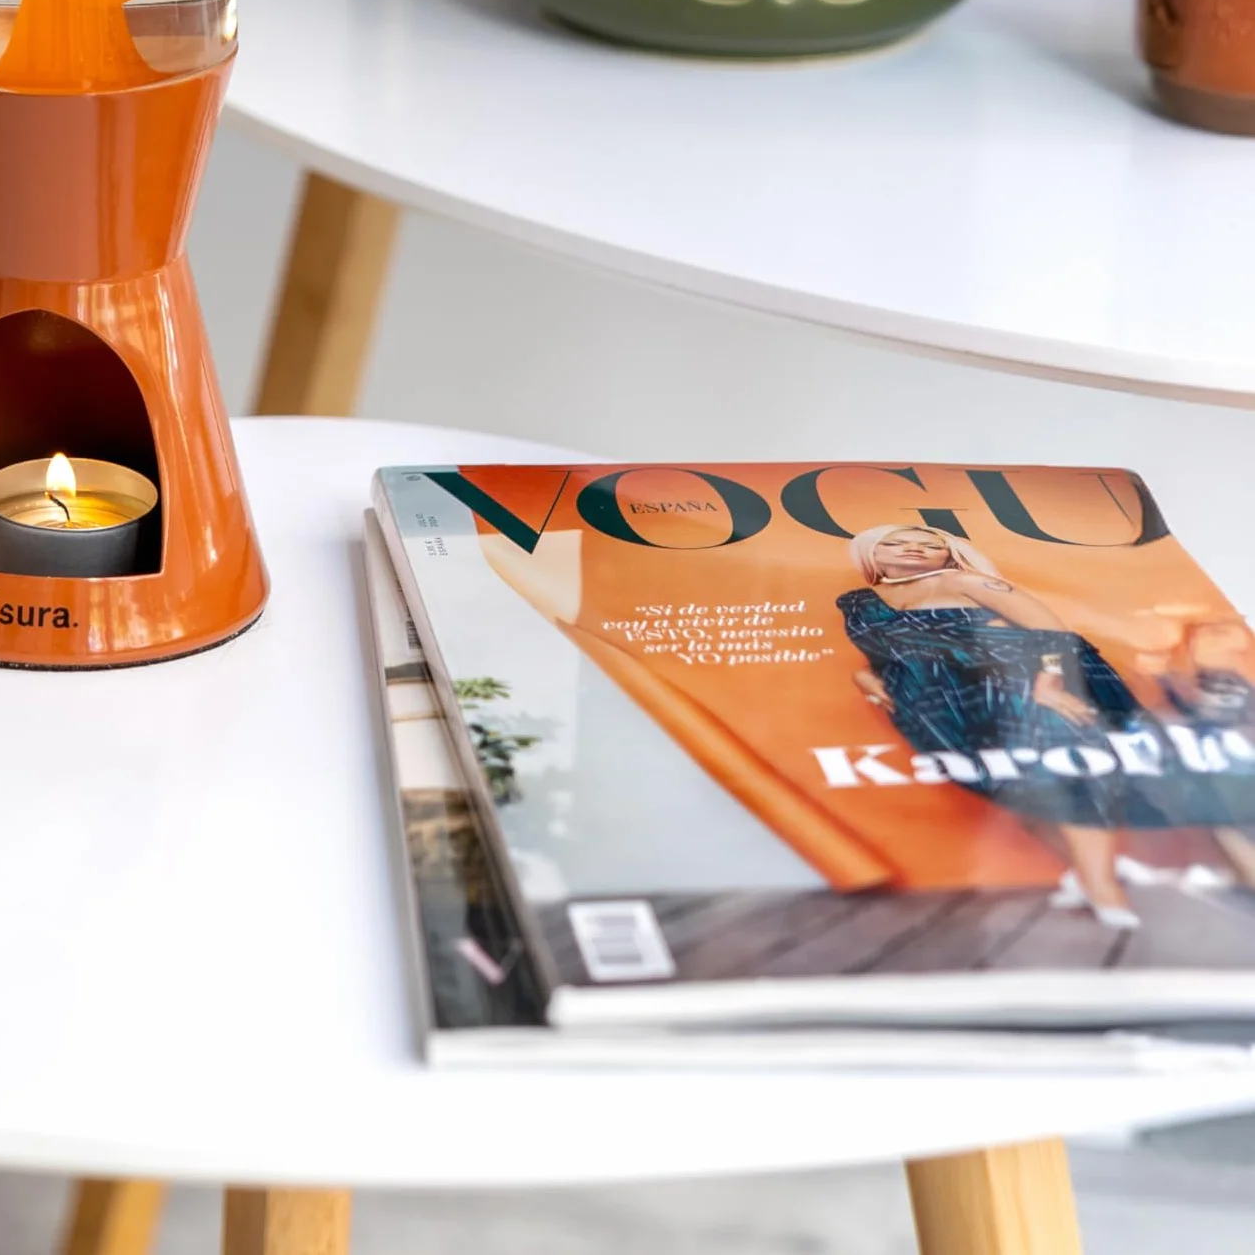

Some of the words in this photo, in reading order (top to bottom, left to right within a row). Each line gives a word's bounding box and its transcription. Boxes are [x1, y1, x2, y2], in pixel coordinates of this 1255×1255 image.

[628, 500, 718, 515] ESPAÑA
[678, 603, 709, 615] de
[715, 600, 806, 615] verdad
[601, 619, 648, 632] voy
[653, 619, 670, 629] a
[677, 615, 740, 628] vivir
[743, 614, 774, 627] de
[625, 628, 714, 642] ESTO,
[719, 625, 824, 639] necesito
[643, 643, 683, 654] ser
[687, 639, 712, 652] lo
[718, 638, 774, 652] más
[676, 652, 722, 665] YO
